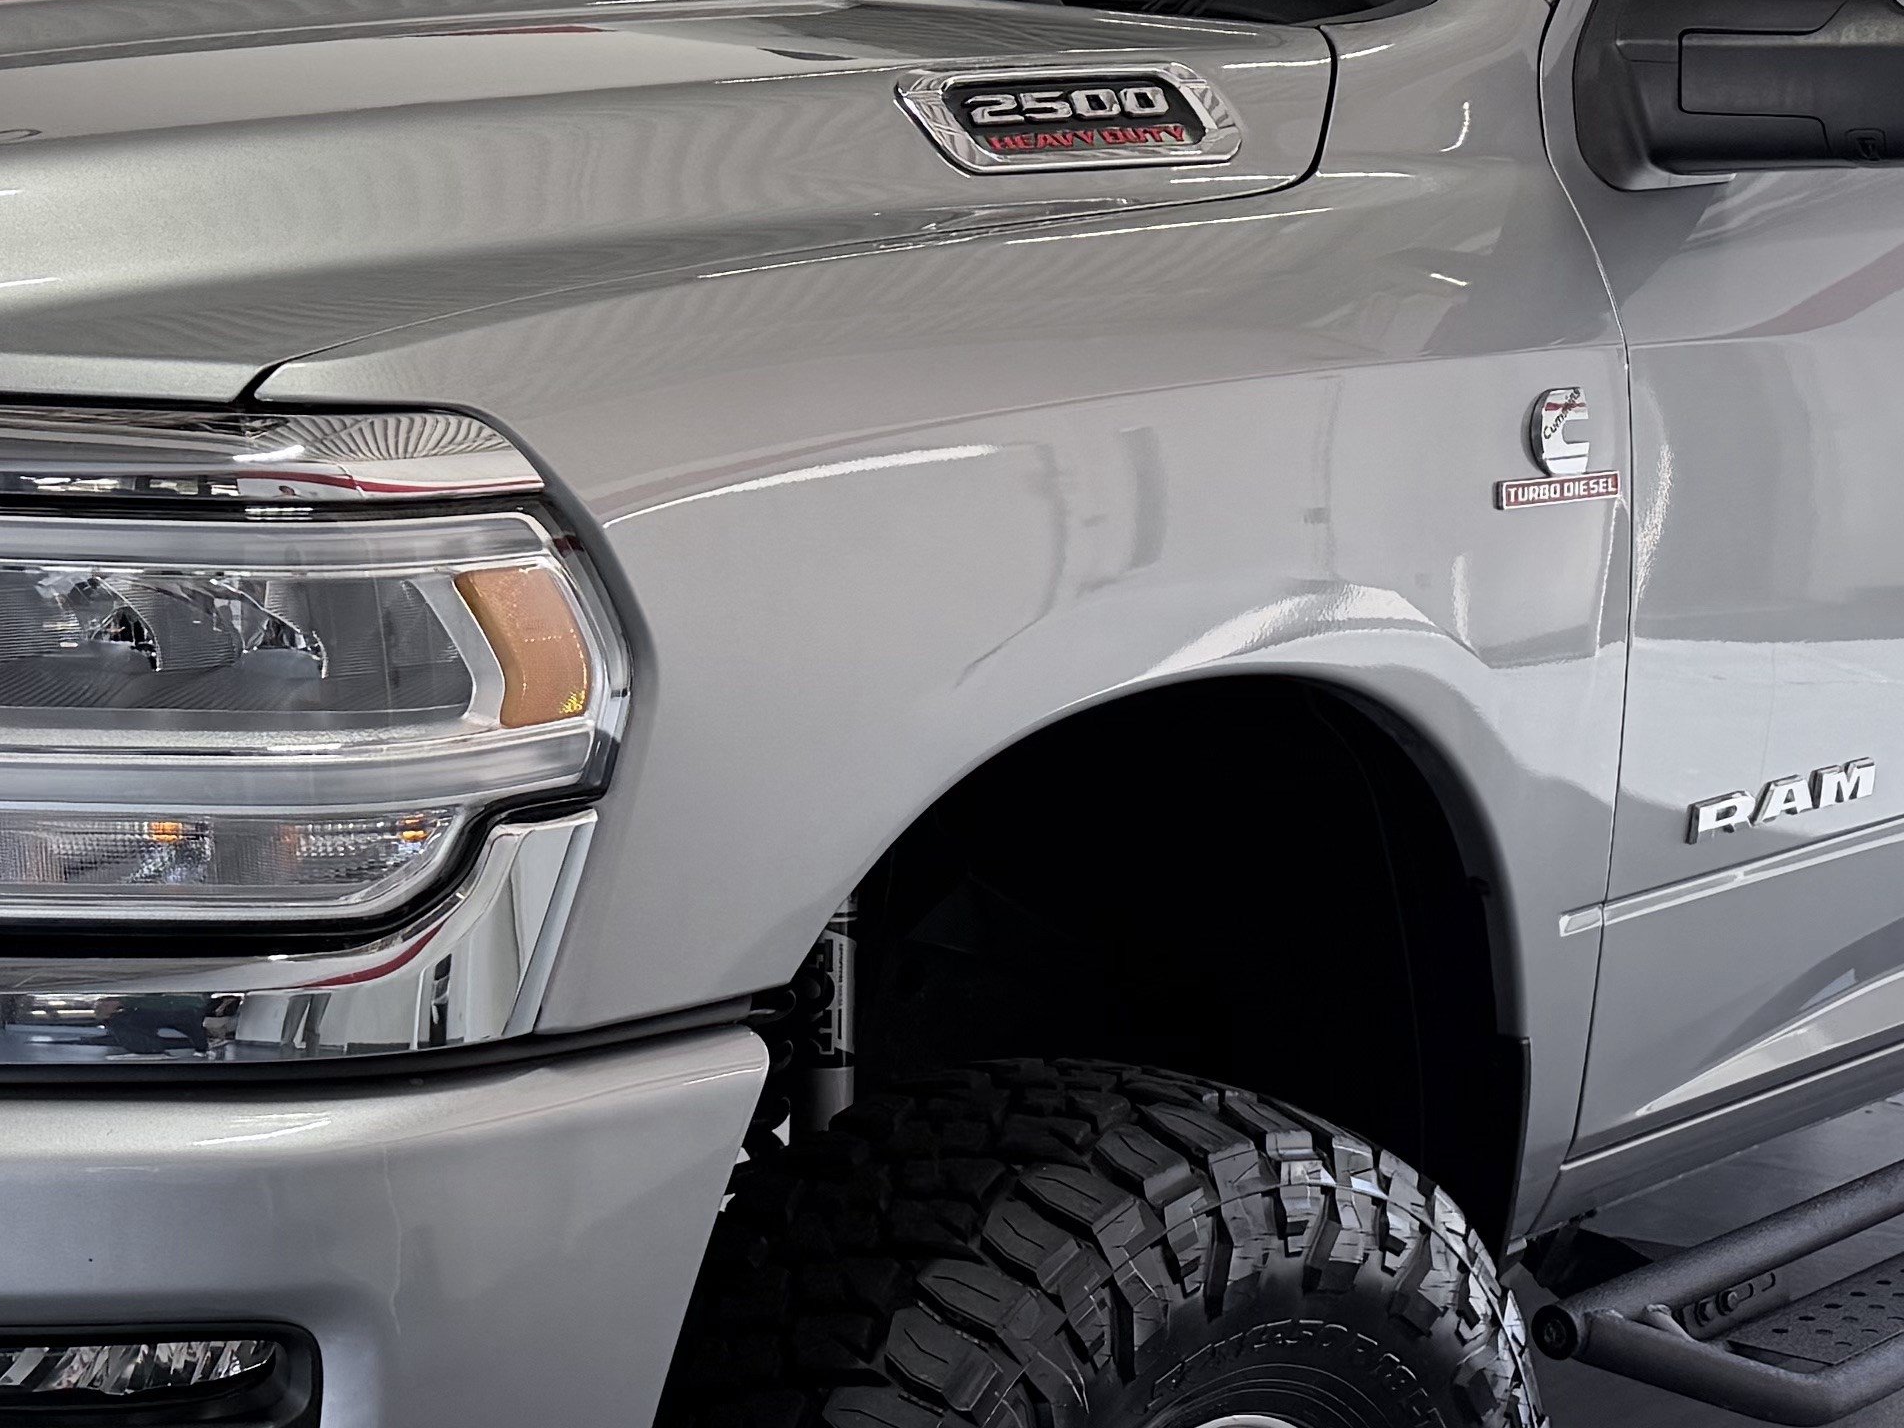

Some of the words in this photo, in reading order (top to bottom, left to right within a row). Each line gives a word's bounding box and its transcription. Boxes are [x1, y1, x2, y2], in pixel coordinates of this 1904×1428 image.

[964, 86, 1171, 127] 2500
[986, 129, 1096, 152] HEAVY
[1097, 124, 1186, 145] DUTY
[1507, 482, 1561, 503] TURBO
[1563, 477, 1617, 497] DIESEL
[1684, 756, 1876, 844] RAM
